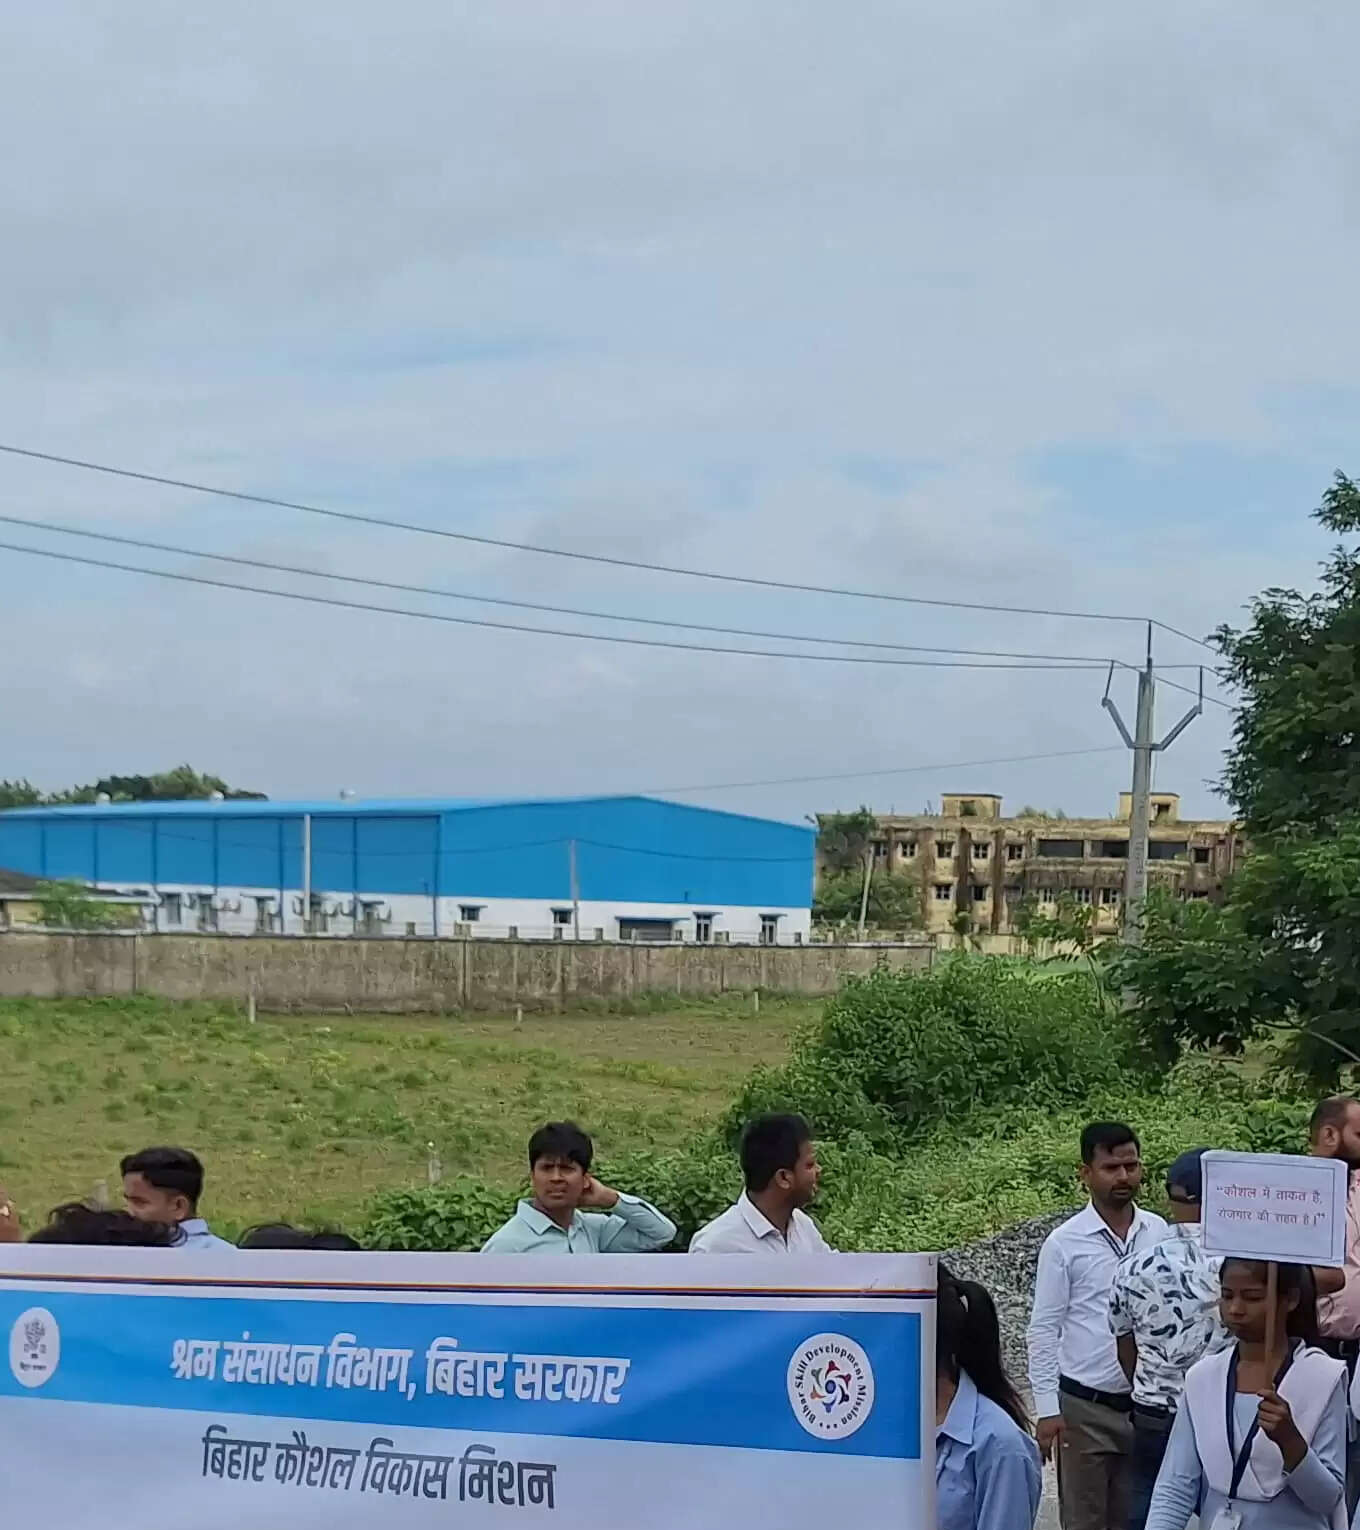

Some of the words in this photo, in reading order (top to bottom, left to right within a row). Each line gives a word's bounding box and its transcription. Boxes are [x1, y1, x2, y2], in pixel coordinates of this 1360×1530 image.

[172, 1338, 220, 1380] श्रम
[223, 1331, 323, 1386] संसाधन
[326, 1333, 416, 1401] विभाग,
[425, 1337, 509, 1399] बिहार
[513, 1352, 631, 1404] सरकार
[795, 1360, 808, 1389] Skill
[805, 1344, 864, 1380] Development
[799, 1392, 816, 1424] Bihar
[841, 1385, 866, 1425] Mission
[201, 1425, 271, 1482] बिहार
[275, 1431, 360, 1491] कौशल
[360, 1438, 458, 1499] विकास
[458, 1444, 557, 1510] मिशन
